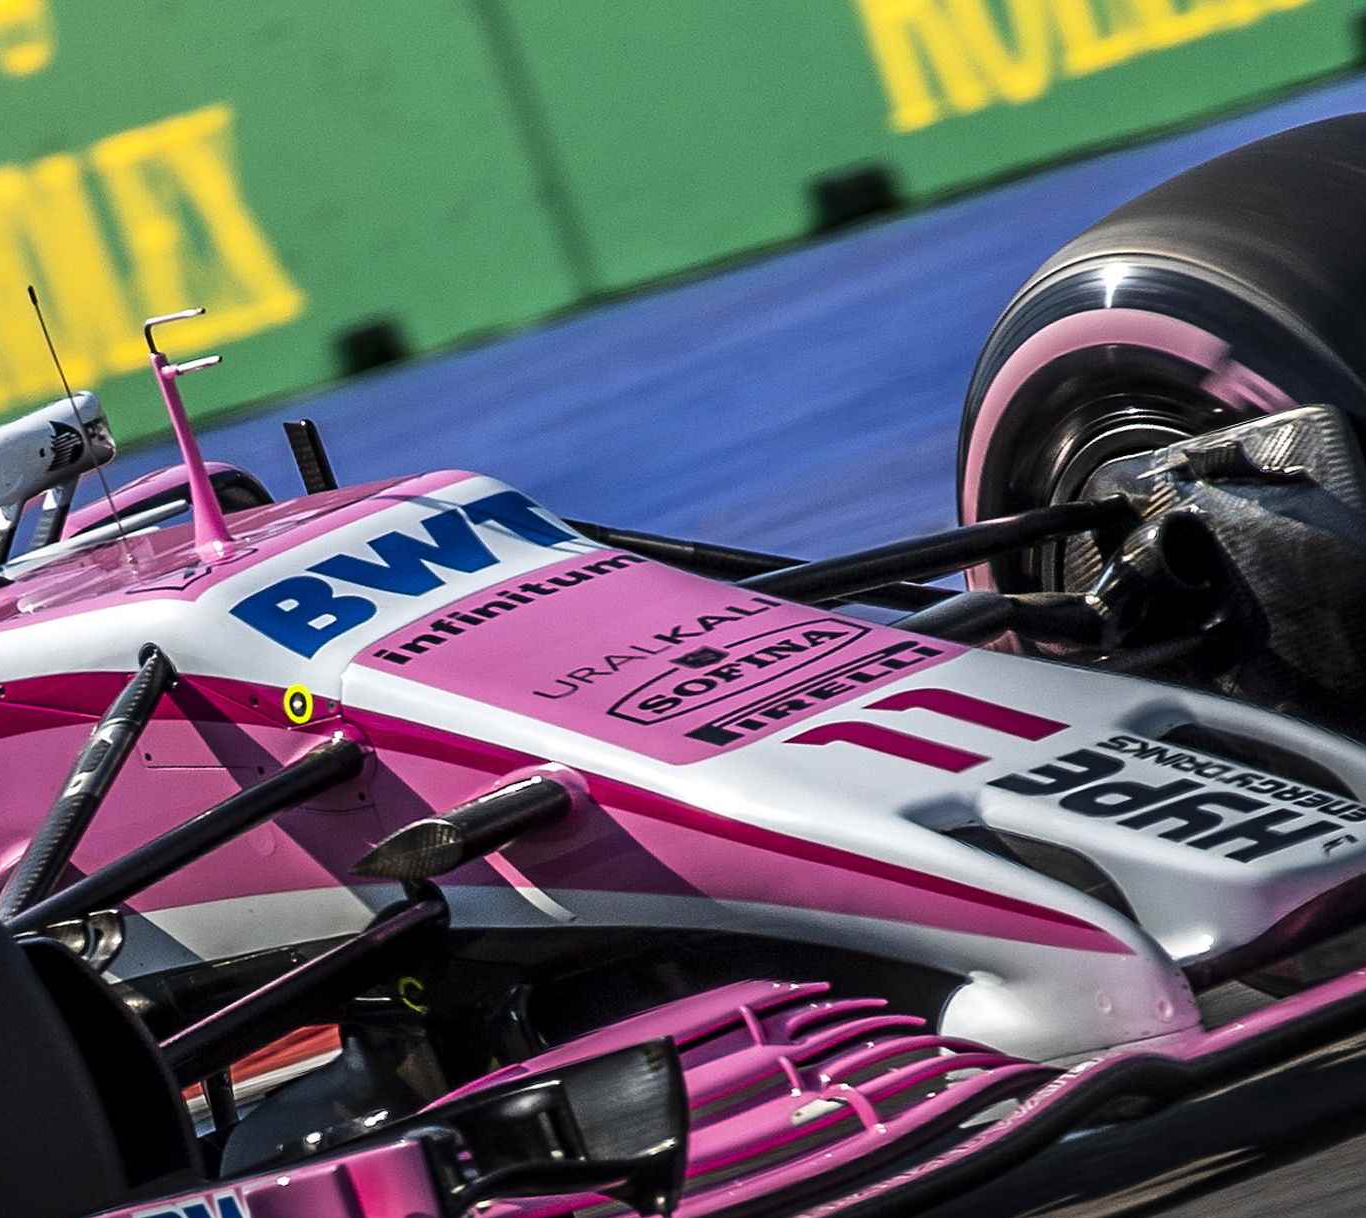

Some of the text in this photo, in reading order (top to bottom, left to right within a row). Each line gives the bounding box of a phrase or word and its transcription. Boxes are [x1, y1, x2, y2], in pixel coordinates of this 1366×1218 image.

[228, 489, 579, 659] BWT
[373, 554, 651, 665] infinitum
[533, 597, 783, 700] URALKALI
[638, 628, 849, 715] SOFINA
[683, 640, 945, 747] PIRELLI
[781, 687, 1069, 774] 11
[1096, 735, 1234, 783] DRINKS
[986, 748, 1346, 864] HYPE
